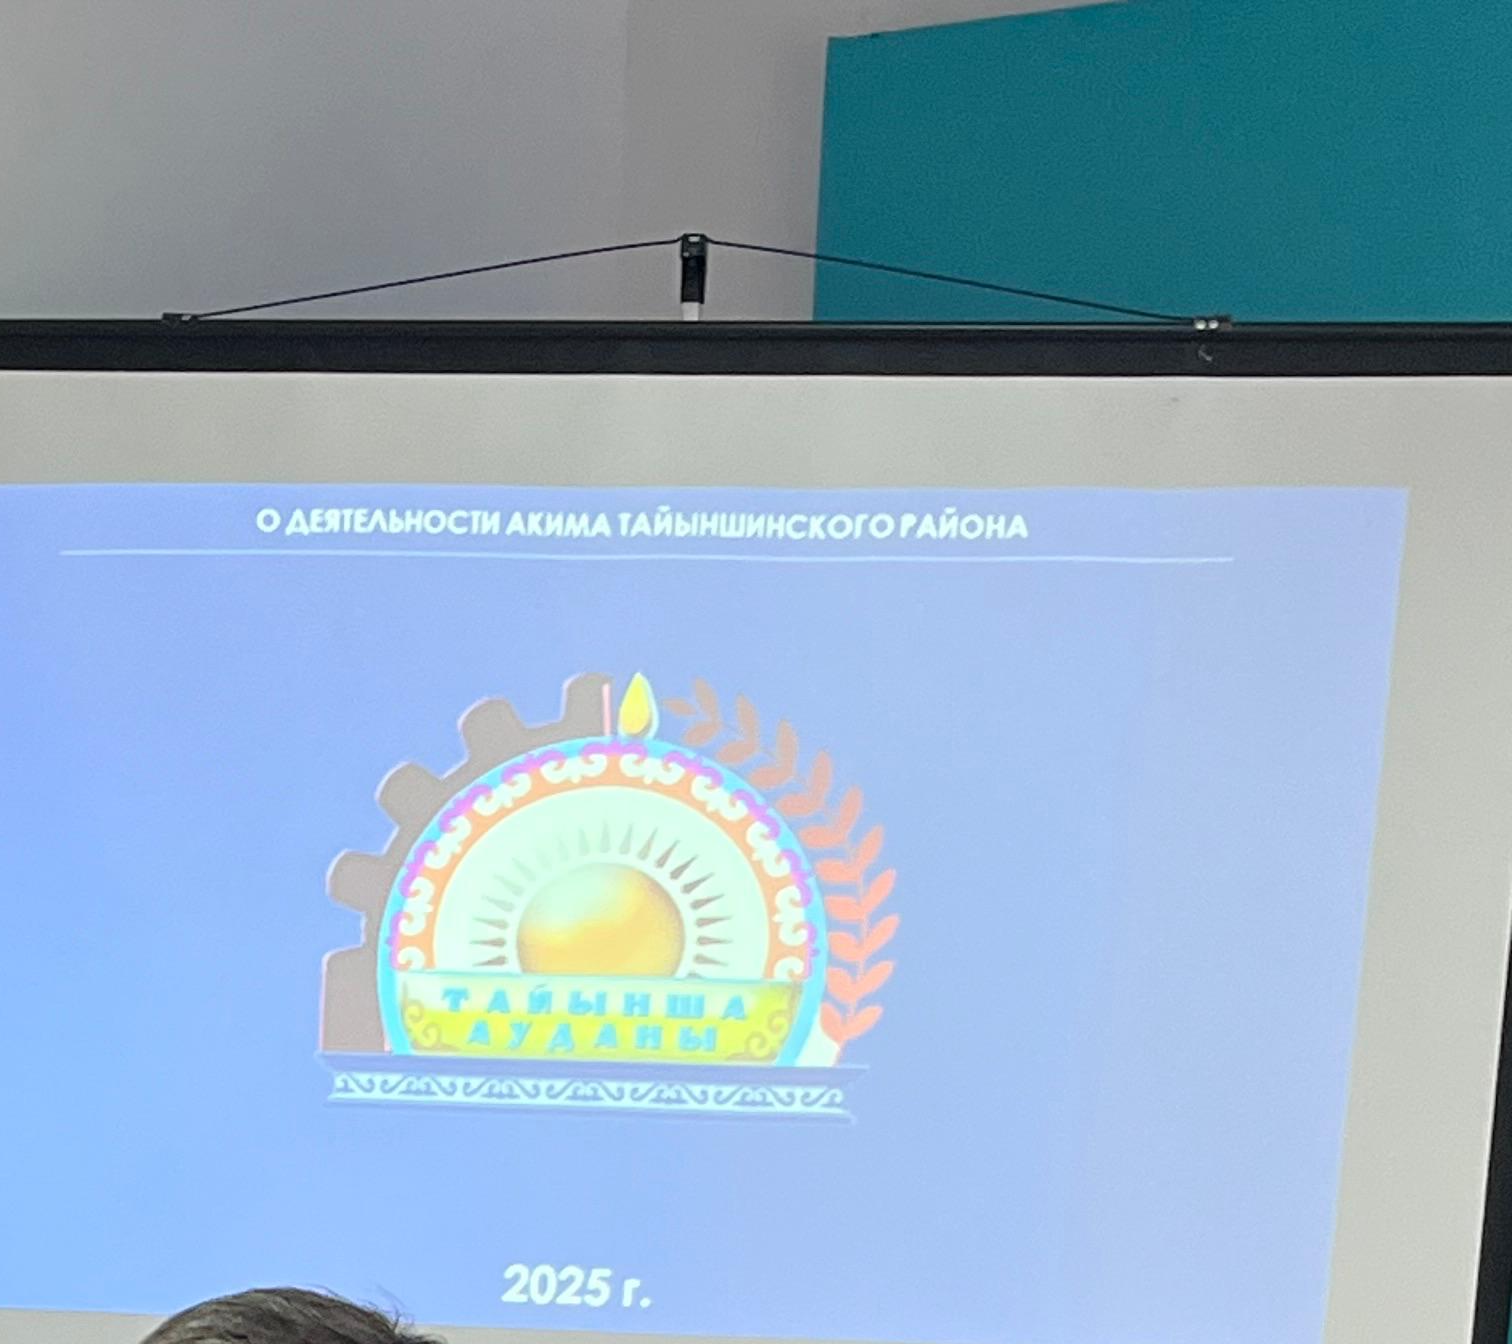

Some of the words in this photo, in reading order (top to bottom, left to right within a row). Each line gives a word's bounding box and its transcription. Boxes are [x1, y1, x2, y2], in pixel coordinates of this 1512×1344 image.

[256, 508, 281, 533] О
[286, 507, 501, 536] ДЕЯТЕЛЬНОСТИ
[505, 511, 612, 538] АКИМА
[618, 505, 895, 539] ТАЙЫНШИНСКОГО
[899, 507, 1029, 539] РАЙОНА
[442, 984, 747, 1020] ТАЙЫНША
[466, 1019, 717, 1053] АУДАНЫ
[501, 1263, 612, 1307] 2025
[621, 1278, 652, 1309] г.
